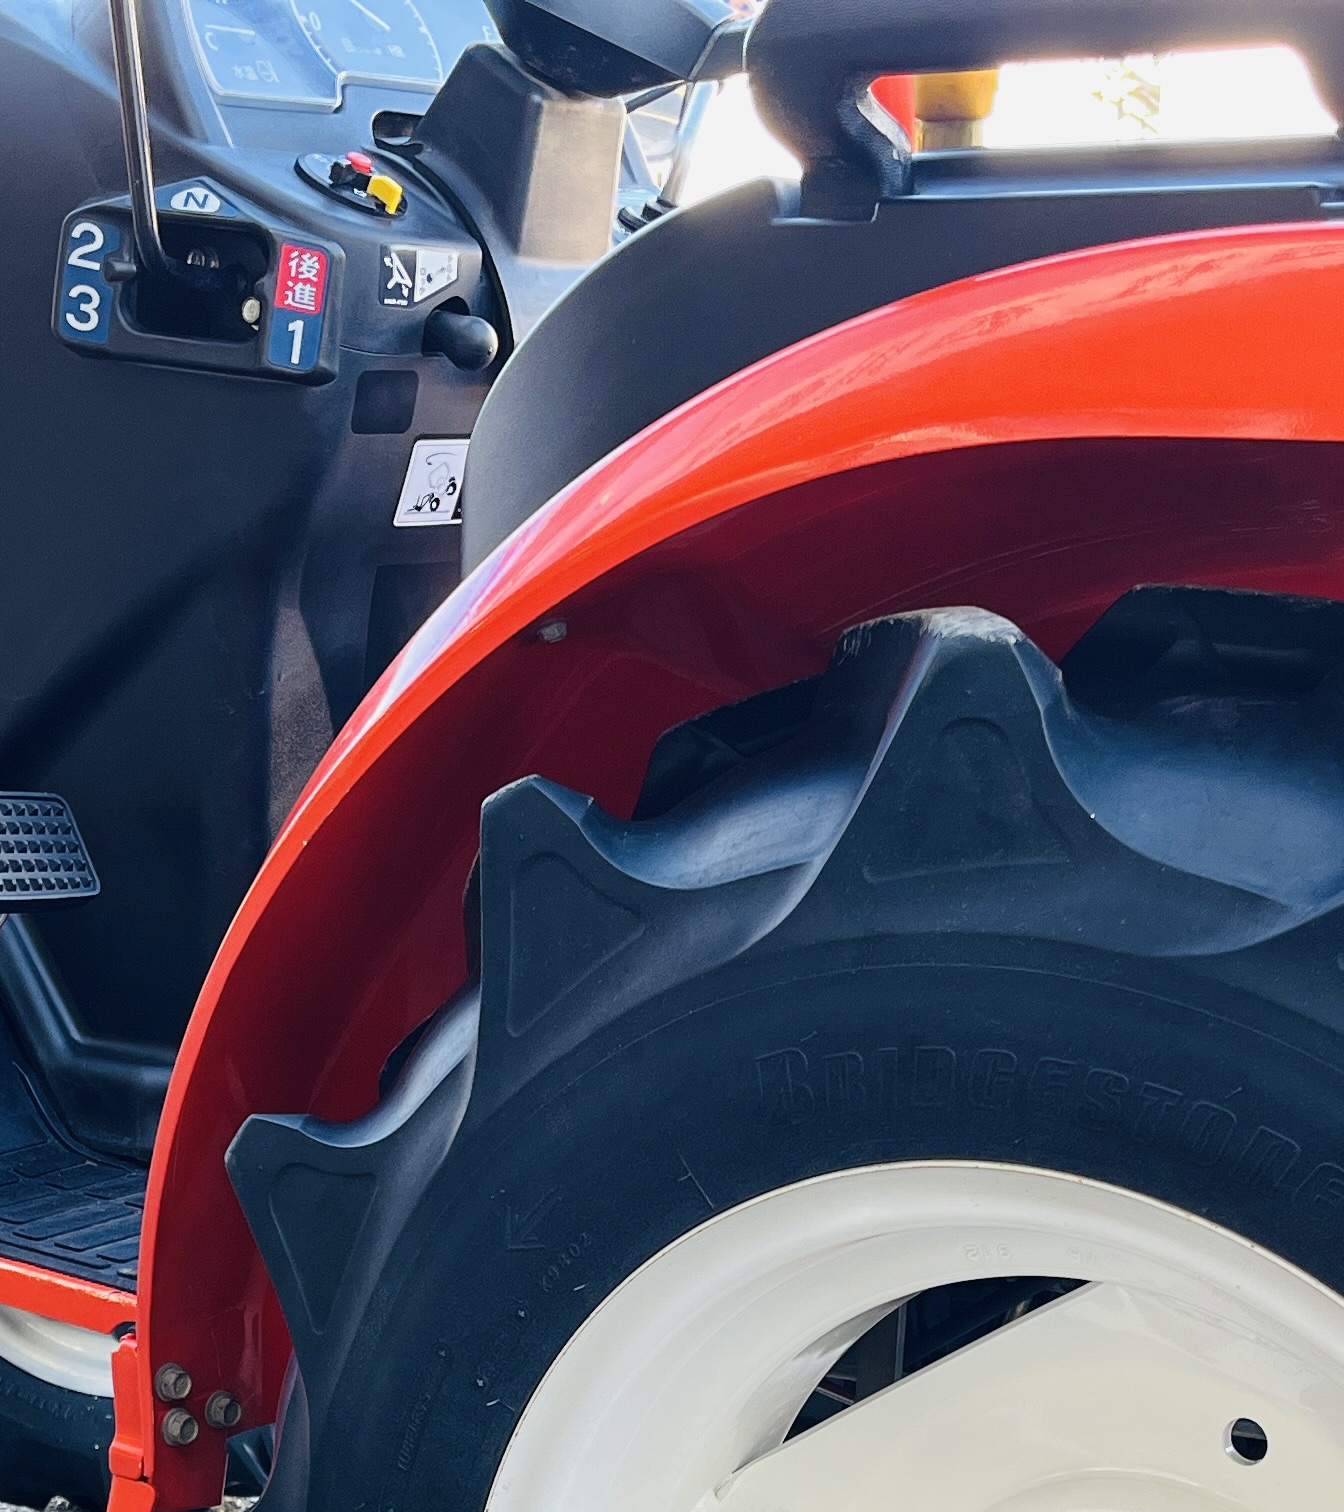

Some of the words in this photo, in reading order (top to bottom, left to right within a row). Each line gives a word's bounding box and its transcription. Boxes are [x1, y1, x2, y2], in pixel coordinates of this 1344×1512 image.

[183, 190, 209, 210] N
[67, 222, 104, 271] 2
[283, 250, 321, 311] 後進
[65, 284, 101, 332] 3
[287, 319, 305, 365] 1
